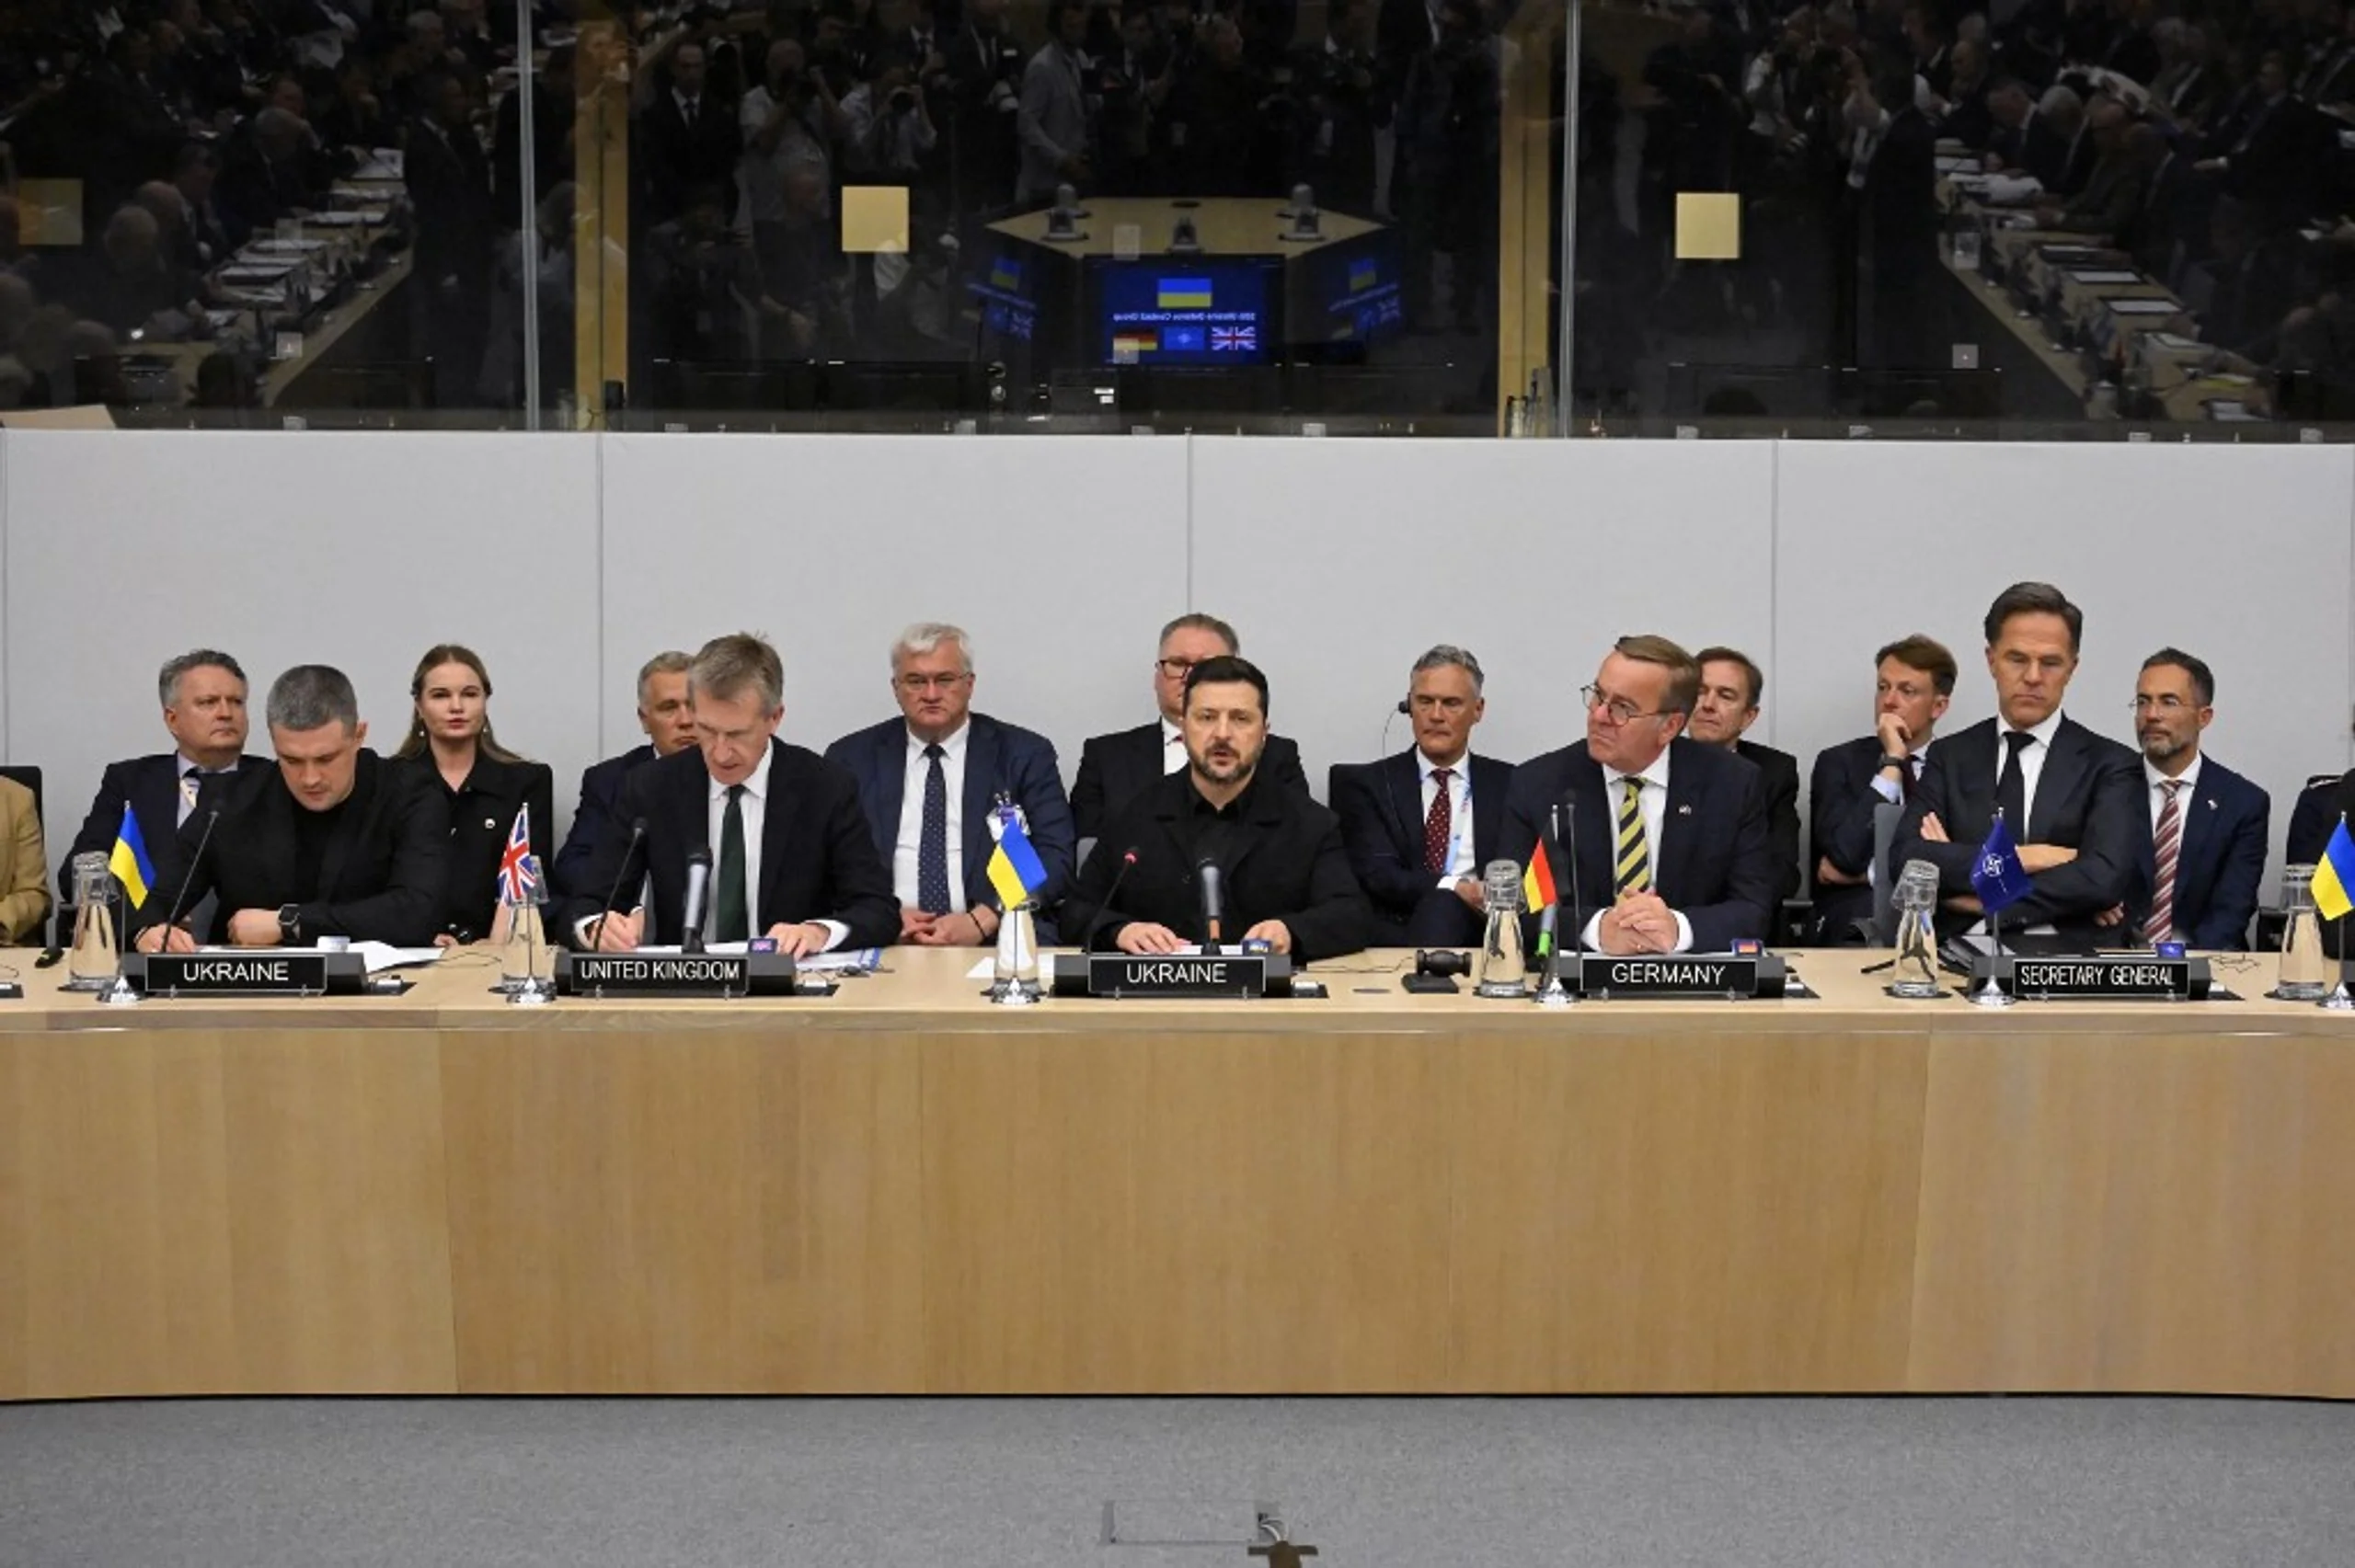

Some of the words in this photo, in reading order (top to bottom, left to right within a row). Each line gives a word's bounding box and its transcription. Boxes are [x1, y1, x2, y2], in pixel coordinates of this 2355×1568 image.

[183, 962, 289, 982] UKRAINE
[580, 961, 648, 980] UNITED
[652, 961, 740, 980] KINGDOM
[1126, 963, 1227, 983] UKRAINE
[1611, 963, 1726, 984] GERMANY
[2020, 965, 2104, 986] SECRETARY
[2109, 965, 2176, 986] GENERAL
